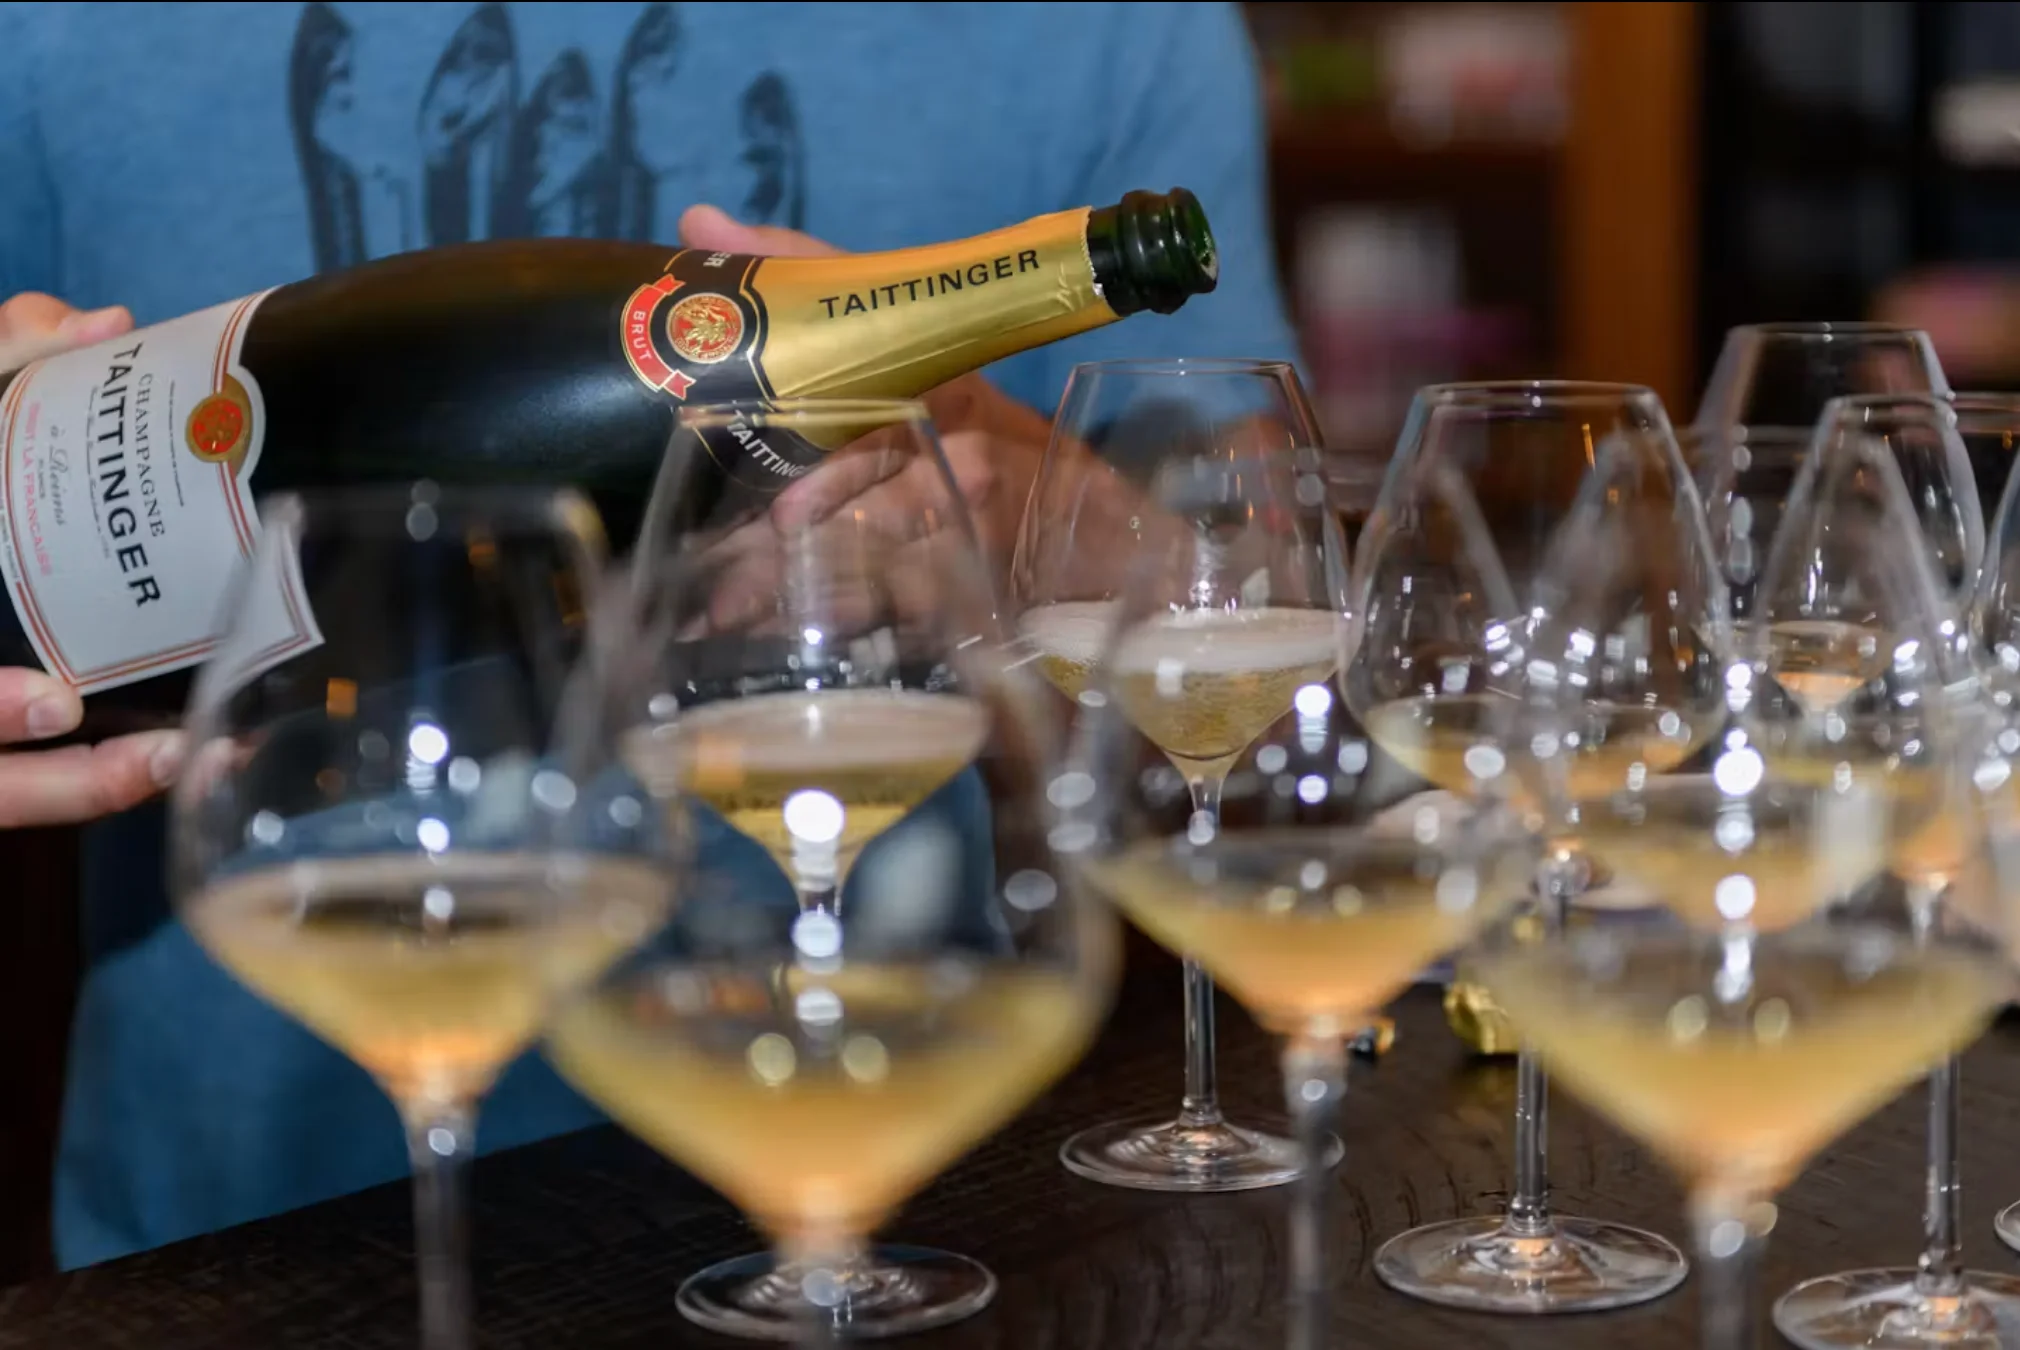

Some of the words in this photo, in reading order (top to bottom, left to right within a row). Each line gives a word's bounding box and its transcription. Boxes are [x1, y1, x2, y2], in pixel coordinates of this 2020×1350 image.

[818, 249, 1040, 319] TAITTINGER
[631, 310, 652, 361] BRUT
[97, 341, 161, 608] TAITTINGER
[135, 373, 165, 538] CHAMPAGNE
[726, 409, 809, 478] TAITTING
